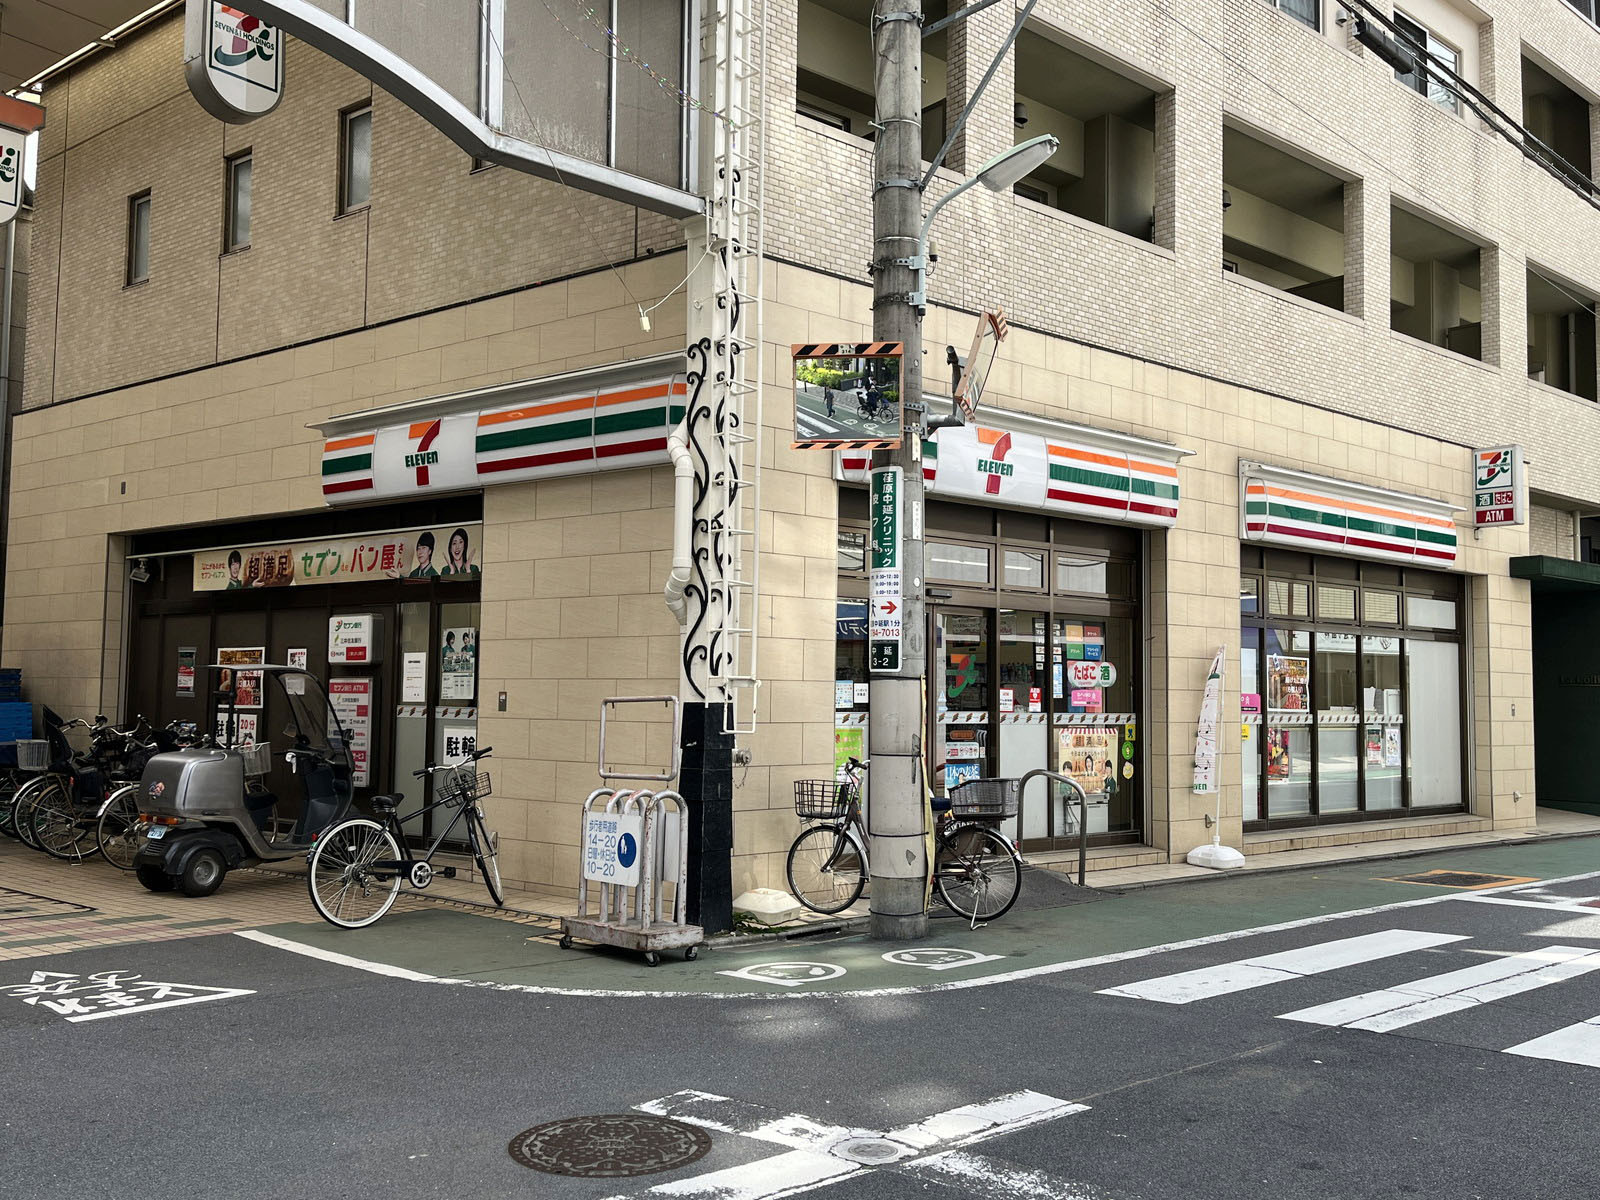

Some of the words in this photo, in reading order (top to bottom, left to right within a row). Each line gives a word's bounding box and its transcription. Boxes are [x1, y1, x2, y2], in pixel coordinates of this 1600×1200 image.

[243, 33, 275, 51] HOLDINGS
[882, 472, 894, 567] 荏原中延クリニック
[1485, 510, 1505, 522] ATM
[248, 555, 289, 580] 超満足
[871, 646, 893, 656] 中延
[872, 657, 889, 666] 3-2
[1073, 664, 1097, 681] たばこ
[1100, 665, 1111, 681] 酒
[589, 820, 617, 834] 歩行者用道路
[588, 833, 617, 849] 14-20
[587, 861, 616, 877] 10-20
[38, 985, 195, 1015] とまれ
